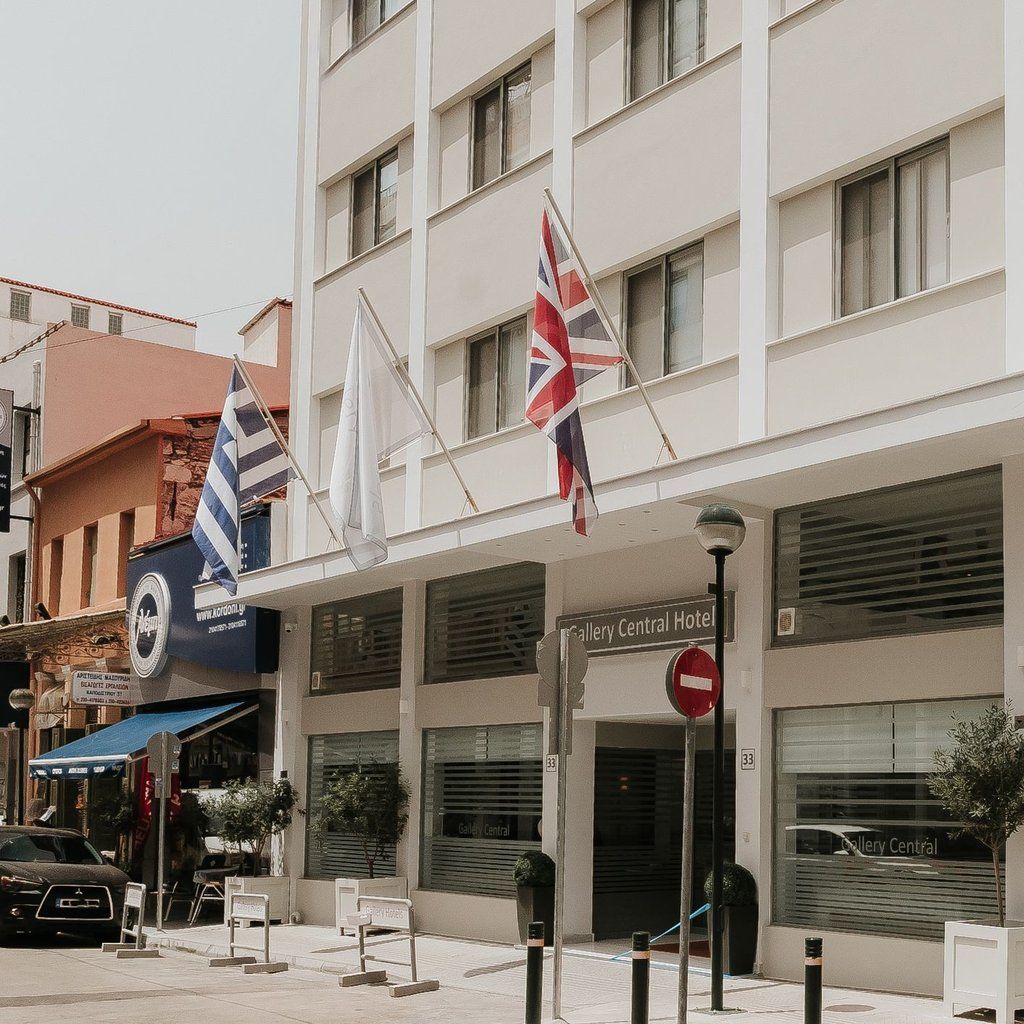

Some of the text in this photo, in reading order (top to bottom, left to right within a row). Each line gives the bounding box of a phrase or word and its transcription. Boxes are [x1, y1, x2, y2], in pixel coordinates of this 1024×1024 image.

[569, 605, 716, 644] Gallery Central Hotel
[547, 757, 556, 768] 33
[742, 753, 754, 765] 33
[484, 823, 510, 837] Central
[841, 835, 938, 856] Gallery Central
